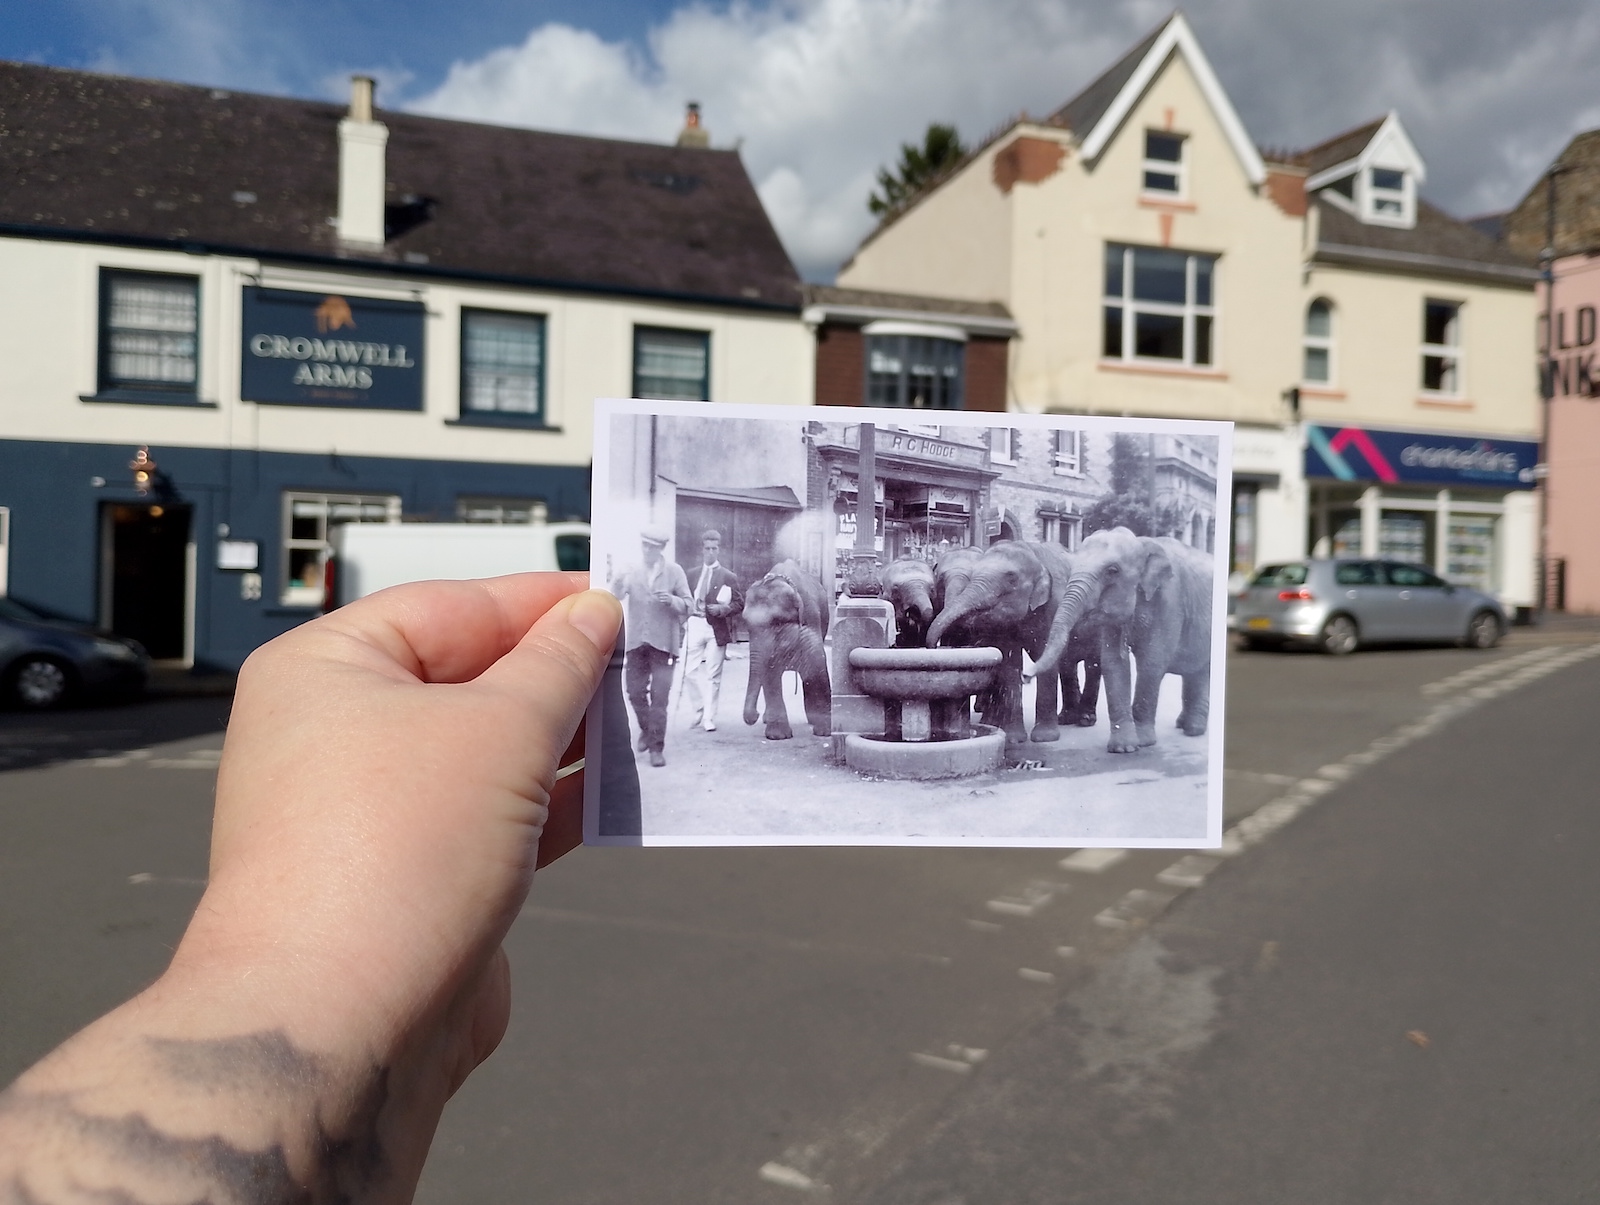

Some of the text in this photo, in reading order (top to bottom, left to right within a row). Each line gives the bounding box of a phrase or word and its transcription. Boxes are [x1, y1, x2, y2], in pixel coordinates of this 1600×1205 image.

[250, 333, 414, 368] CROMWELL
[293, 361, 373, 389] ARMS
[892, 435, 902, 449] R
[920, 439, 956, 458] HODGE
